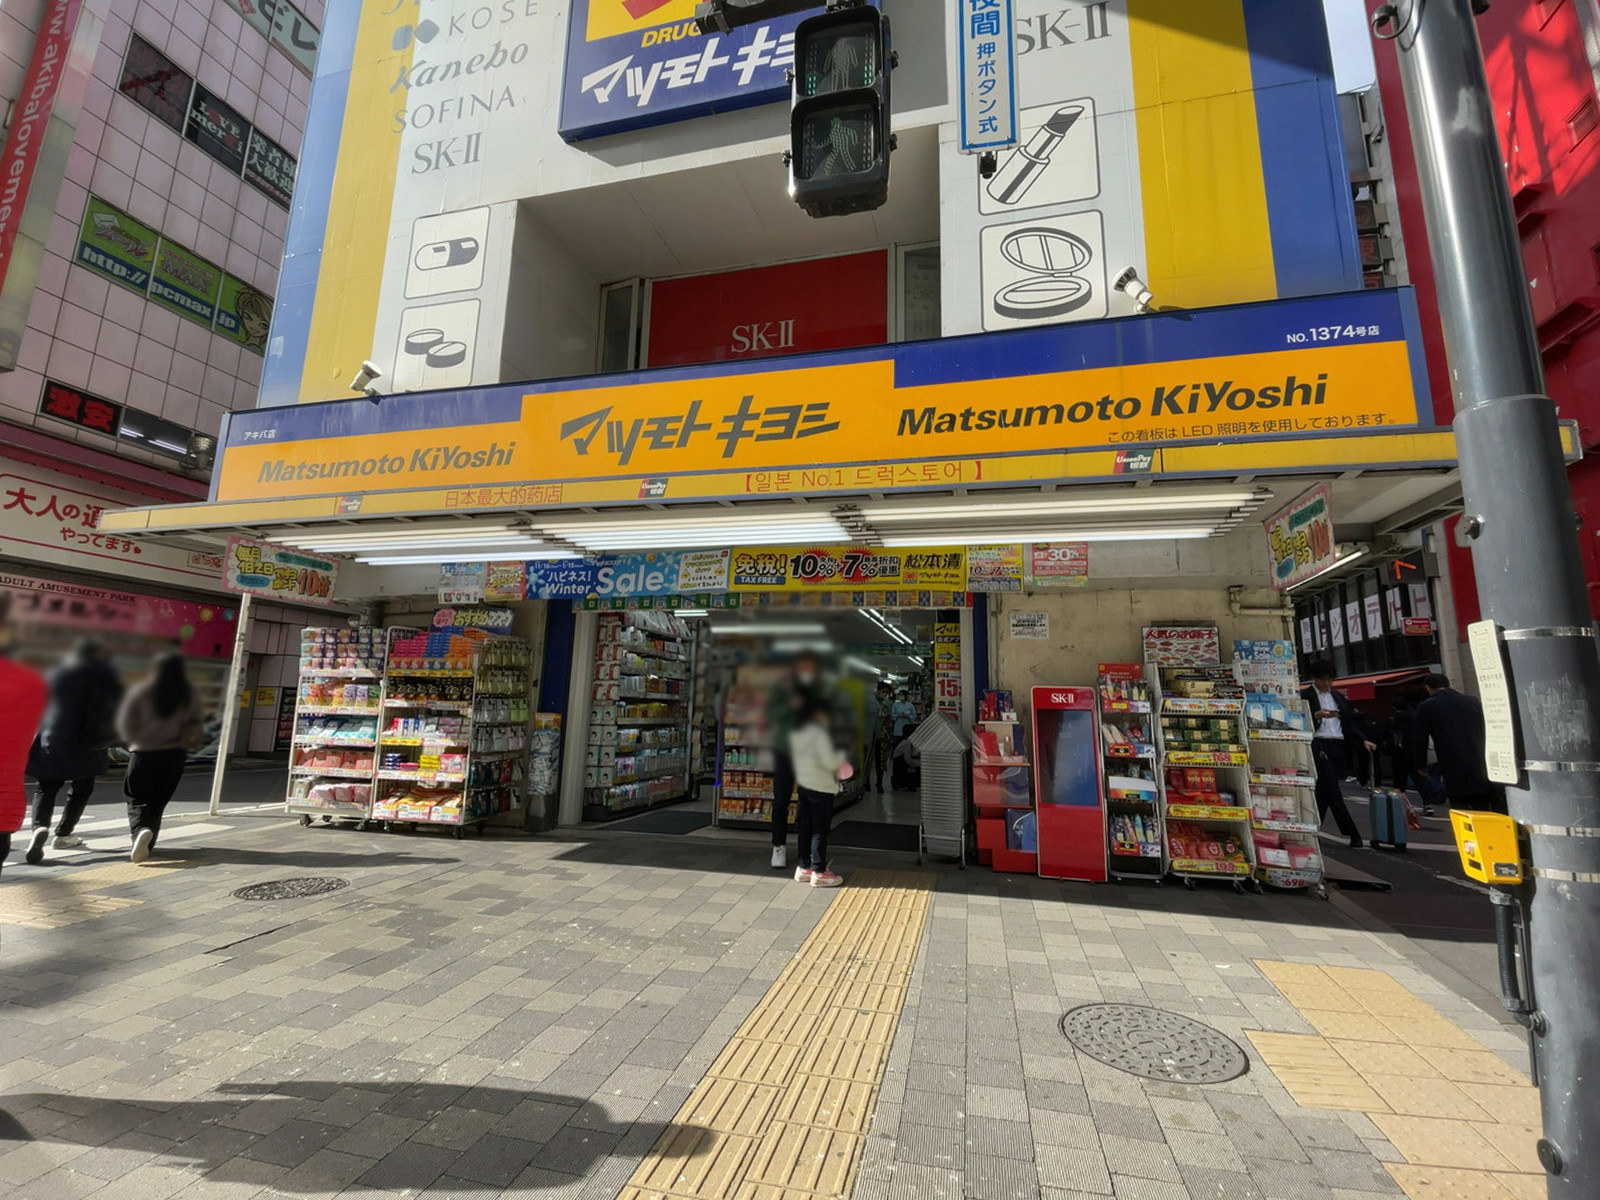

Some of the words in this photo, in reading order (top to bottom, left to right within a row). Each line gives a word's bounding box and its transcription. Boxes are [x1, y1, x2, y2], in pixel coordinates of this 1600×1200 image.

[389, 39, 529, 94] Kanebo
[976, 41, 999, 134] 押ボタン式
[411, 131, 483, 175] SK-II
[731, 319, 796, 353] SK-II
[896, 395, 1142, 437] Matsumoto
[1149, 373, 1329, 418] KiYoshi
[243, 429, 277, 442] アキバ店
[560, 394, 841, 466] マツモトキヨシ
[1108, 427, 1177, 443] この看板は
[1182, 424, 1213, 438] LED
[1217, 412, 1397, 435] 照明を使用しております。
[257, 454, 405, 483] Matsumoto
[408, 440, 517, 473] KiYoshi
[801, 469, 843, 488] No.1
[854, 460, 962, 486] 드럭스토어
[444, 484, 562, 509] 日本最大的药店
[60, 526, 135, 554] やってます
[37, 578, 107, 600] AMUSEMENT
[545, 582, 592, 595] Winter
[596, 564, 665, 595] Sale
[740, 576, 756, 584] TAX
[757, 576, 778, 584] FREE
[1051, 692, 1075, 704] SK-II
